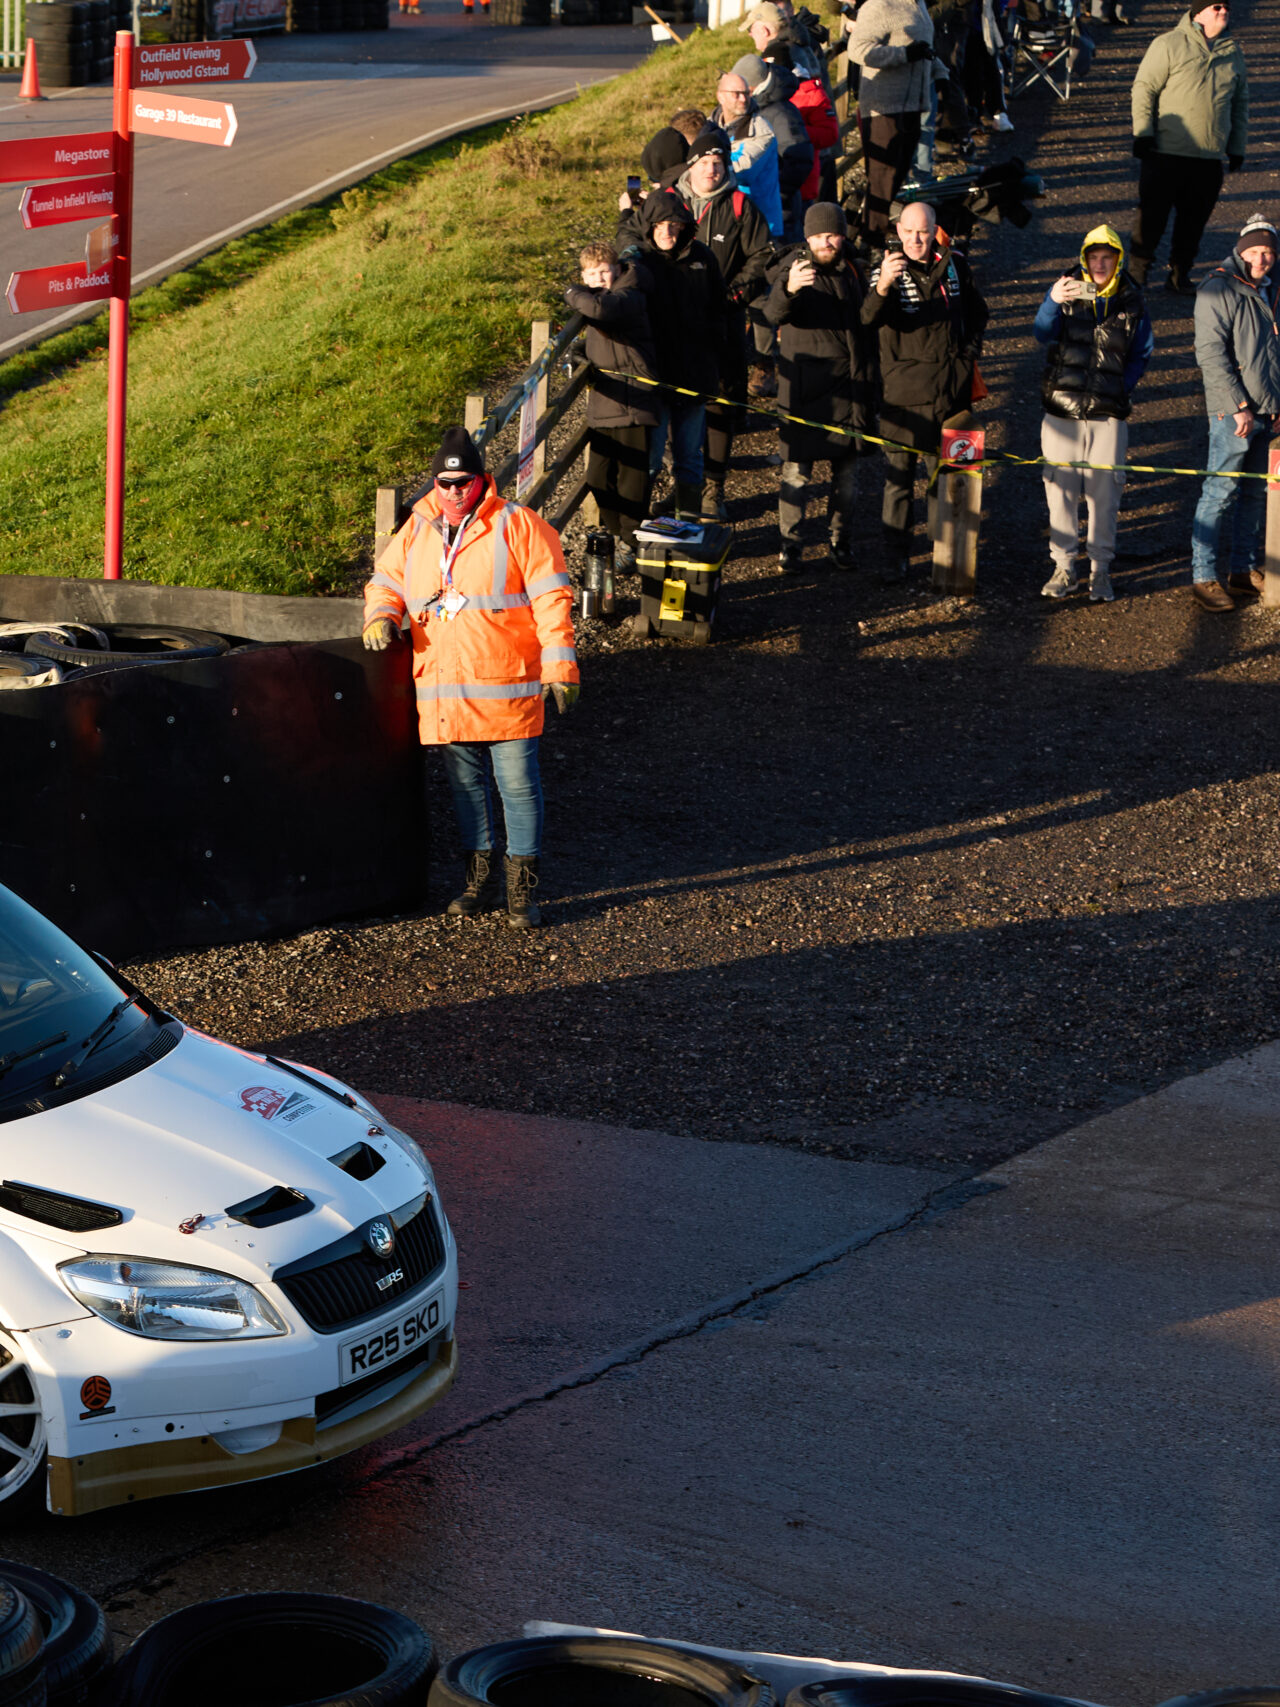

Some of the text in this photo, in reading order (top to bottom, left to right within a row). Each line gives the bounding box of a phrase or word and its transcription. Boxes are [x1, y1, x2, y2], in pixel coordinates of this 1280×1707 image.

[140, 46, 221, 63] Outfield Viewing
[140, 65, 193, 83] Hollywood
[135, 104, 222, 130] Garage 39 Restaurant
[54, 148, 110, 165] Megastore
[31, 189, 114, 213] Tunnel to Infield Viewing
[48, 271, 110, 293] Pits & Paddock
[350, 1300, 439, 1374] R25 SKO
